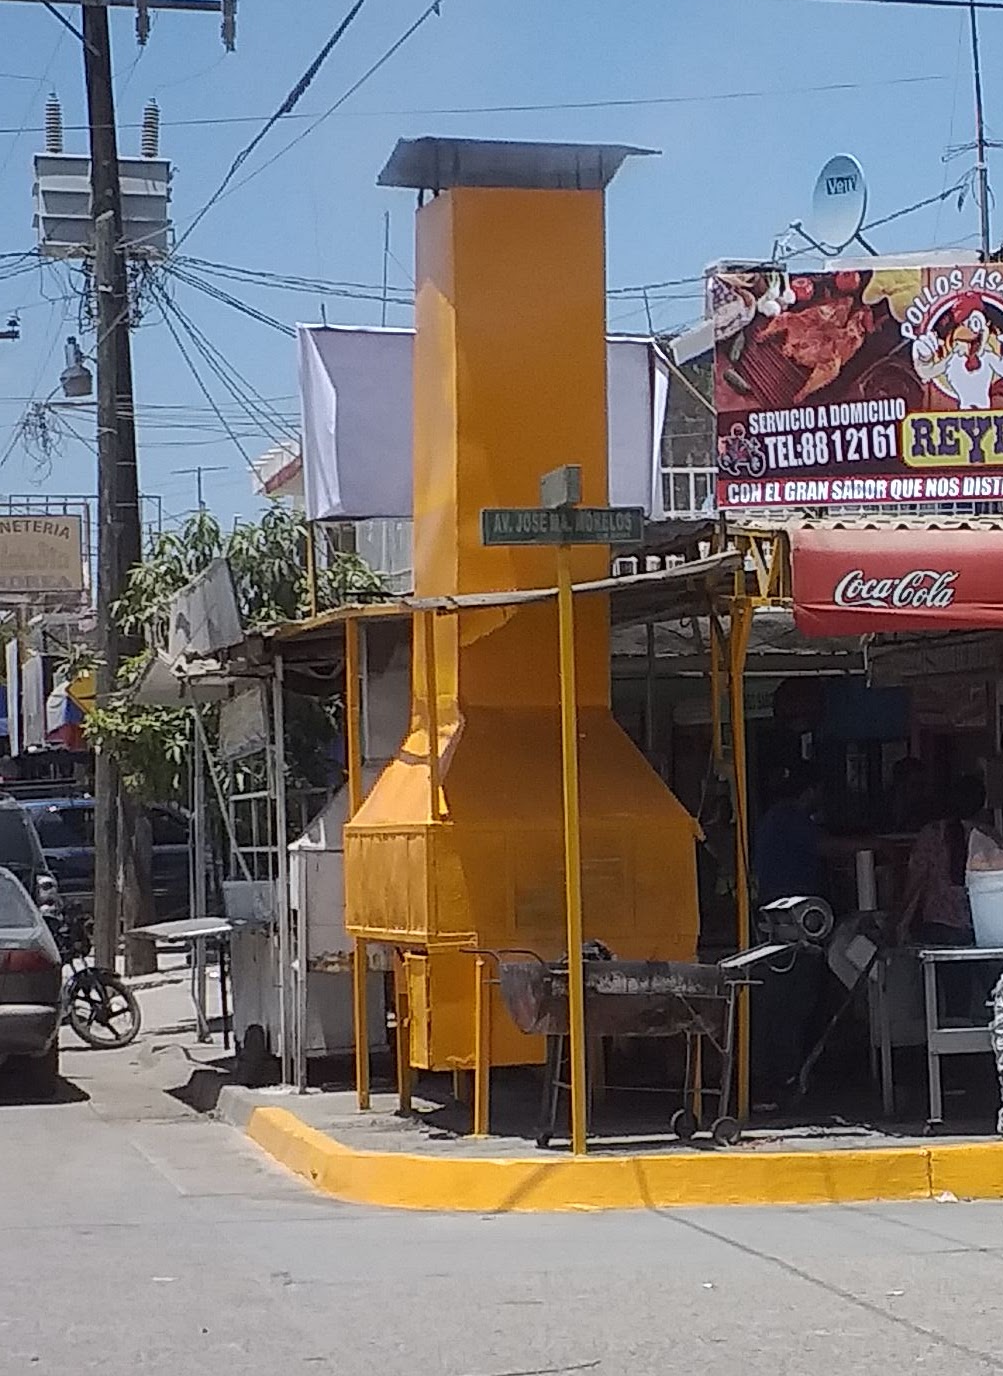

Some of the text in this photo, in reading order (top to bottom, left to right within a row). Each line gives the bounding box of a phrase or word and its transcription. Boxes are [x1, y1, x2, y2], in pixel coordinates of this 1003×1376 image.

[900, 269, 963, 340] POLLOS
[748, 398, 906, 435] SERVICIO A DOMICILIO
[728, 482, 762, 504] CON
[765, 482, 782, 502] EL
[784, 481, 829, 502] GRAN
[831, 479, 888, 500] SABOR
[890, 477, 923, 501] QUE
[925, 477, 961, 497] NOS
[493, 512, 513, 533] AV.
[515, 512, 548, 533] JOSE
[575, 511, 632, 533] MORELOS
